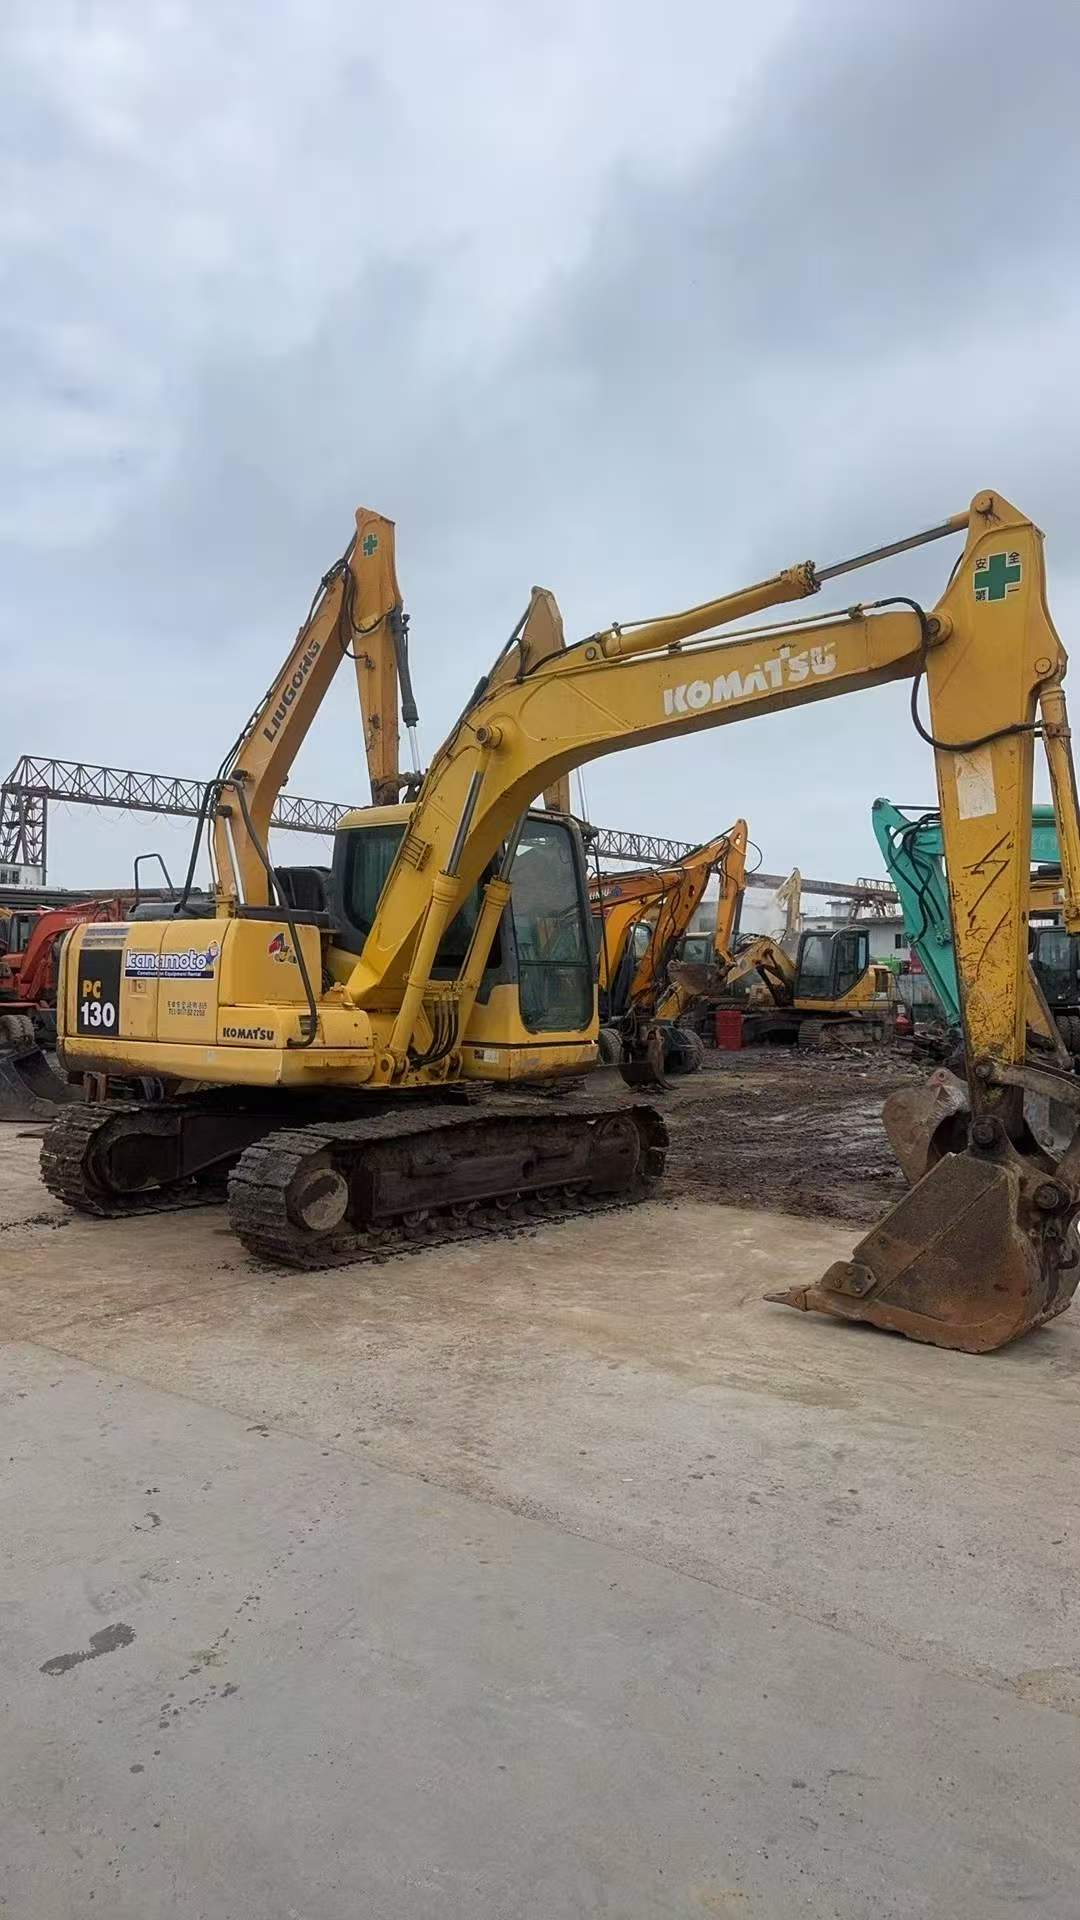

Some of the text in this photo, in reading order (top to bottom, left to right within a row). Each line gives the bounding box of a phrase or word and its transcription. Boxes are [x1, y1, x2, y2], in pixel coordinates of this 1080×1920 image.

[663, 646, 837, 716] KOMATSU
[125, 949, 207, 969] kanamoto
[82, 980, 102, 999] PC
[81, 1001, 116, 1027] 130
[222, 1027, 275, 1041] KOMATSU
